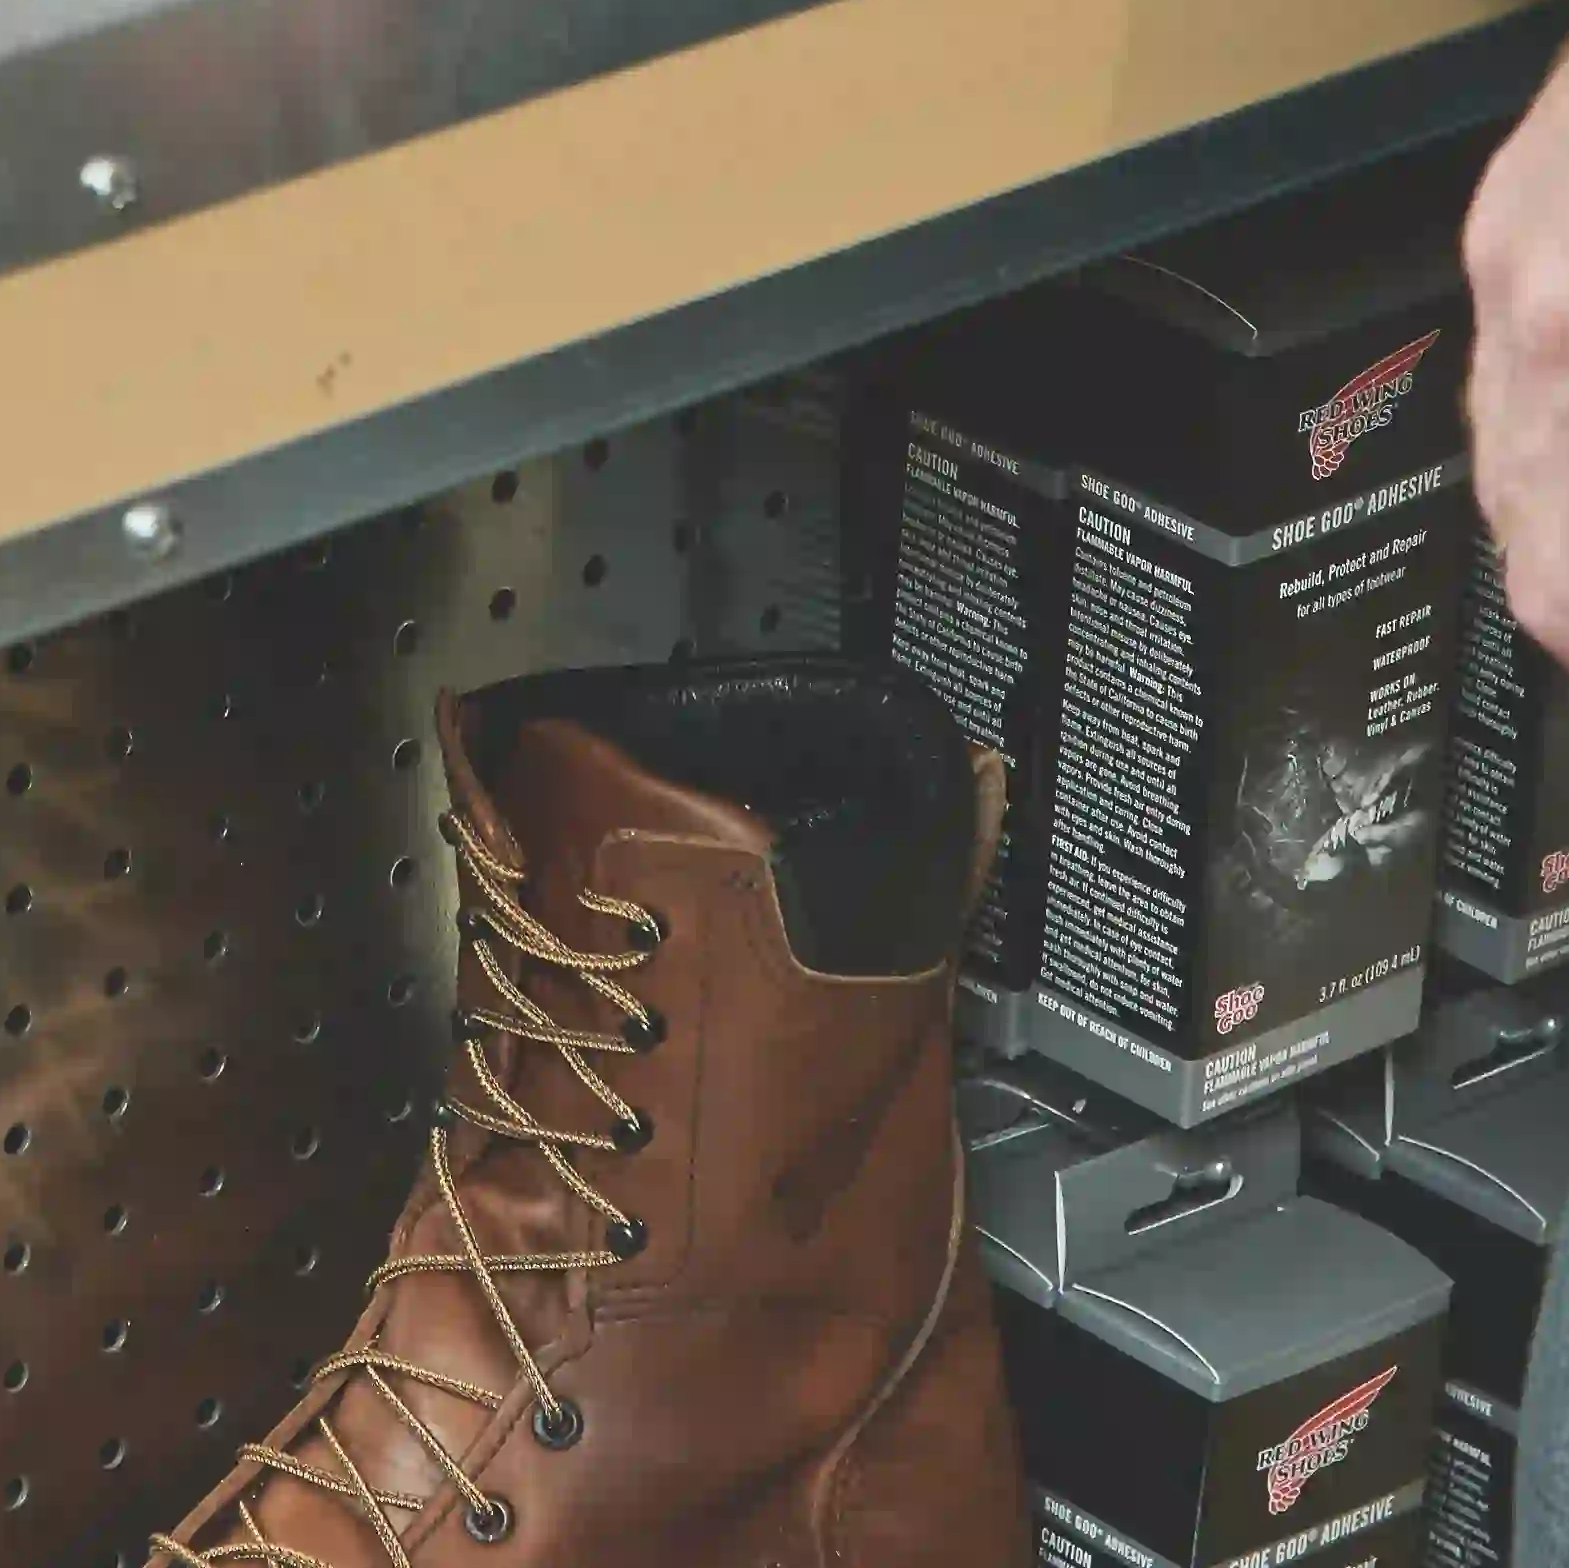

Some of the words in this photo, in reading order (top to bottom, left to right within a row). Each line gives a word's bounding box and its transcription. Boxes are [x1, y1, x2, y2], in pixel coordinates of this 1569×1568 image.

[1298, 399, 1348, 432] RED
[1351, 371, 1414, 410] WING
[1317, 405, 1393, 448] SHOES
[908, 442, 959, 481] CAUTION
[971, 442, 1020, 476] ADHESIVE
[1079, 506, 1131, 547] CAUTION
[1081, 473, 1110, 500] SHOE
[1143, 506, 1196, 542] ADHESIVE
[1272, 515, 1316, 551] SHOE
[1367, 465, 1443, 516] ADHESIVE
[1076, 527, 1125, 561] FLAMMABLE
[1126, 550, 1153, 574] VAPOR
[1279, 570, 1325, 599] Rebuild,
[1328, 553, 1367, 582] Protect
[1370, 543, 1390, 564] and
[1392, 529, 1428, 556] Repair
[1296, 603, 1311, 619] for
[1313, 595, 1325, 611] all
[1327, 584, 1352, 608] types
[1355, 579, 1365, 598] of
[1366, 565, 1406, 592] footwear
[1376, 619, 1397, 639] FAST
[1399, 604, 1432, 628] REPAIR
[1372, 635, 1432, 671] WATERPROOF
[1369, 680, 1400, 703] WORKS
[1403, 672, 1416, 688] ON
[1367, 718, 1388, 737] Vinyl
[1390, 714, 1396, 726] &
[1400, 702, 1431, 723] Canvas
[1318, 986, 1336, 1003] 3.7
[1351, 972, 1363, 988] oz
[1037, 992, 1059, 1012] KEEP
[1060, 1004, 1077, 1022] OUT
[1077, 1014, 1089, 1029] OF
[1090, 1021, 1117, 1045] REACH
[1118, 1036, 1129, 1051] OF
[1130, 1042, 1172, 1072] CHILDREN
[1205, 1043, 1257, 1079] CAUTION
[1256, 1436, 1305, 1473] RED
[1307, 1408, 1371, 1448] WING
[1273, 1438, 1350, 1483] SHOES
[1043, 1496, 1075, 1523] SHOE
[1104, 1531, 1154, 1568] ADHESIVE
[1319, 1495, 1395, 1546] ADHESIVE
[1040, 1526, 1093, 1568] CAUTION
